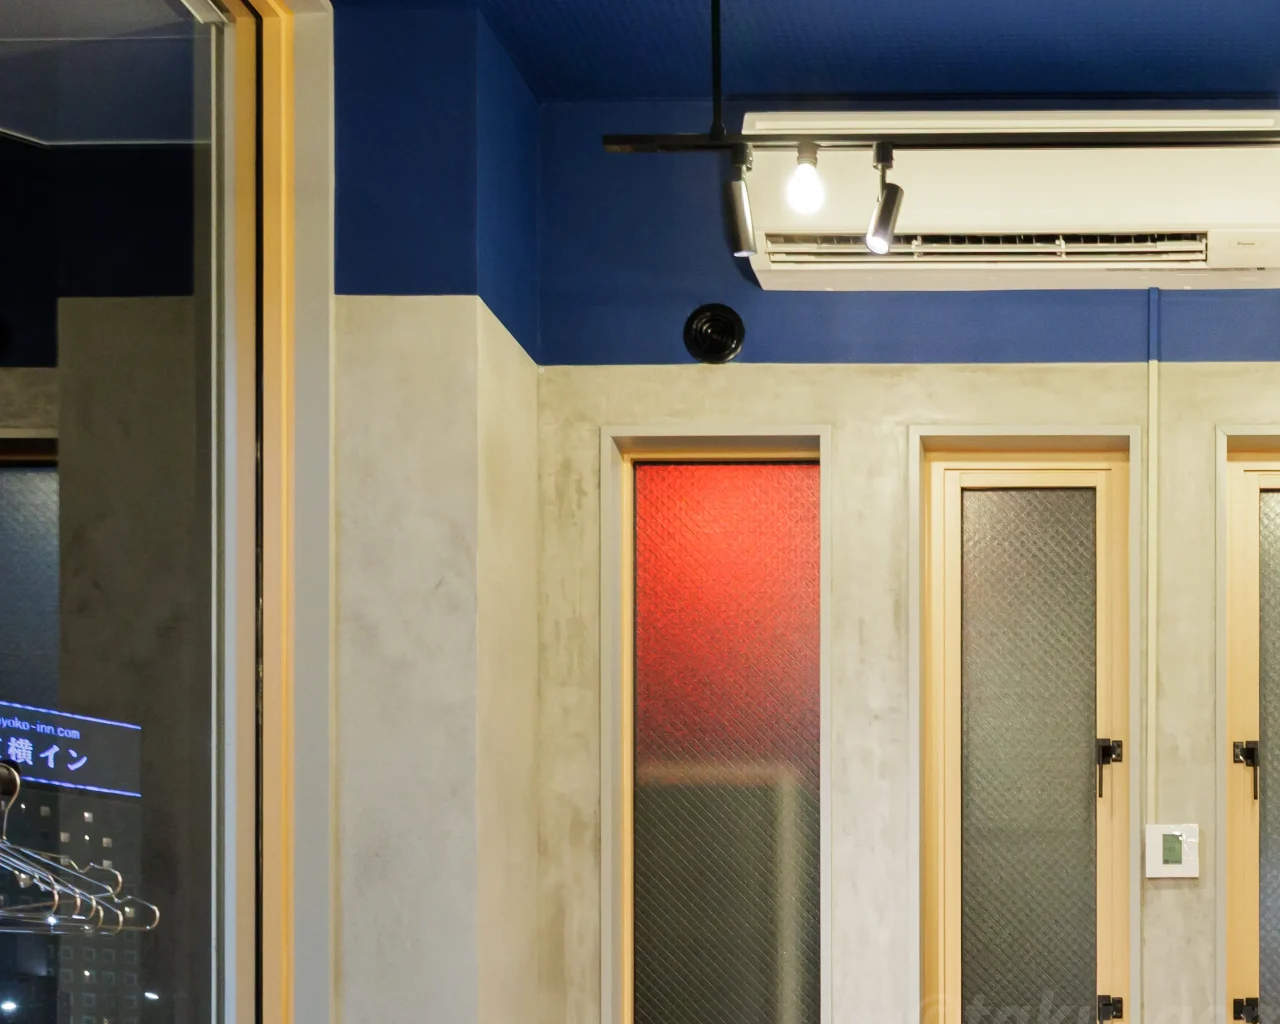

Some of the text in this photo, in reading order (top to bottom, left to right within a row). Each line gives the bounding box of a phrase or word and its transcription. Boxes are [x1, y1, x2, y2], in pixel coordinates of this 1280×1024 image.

[0, 716, 81, 740] yoko-inn.com
[0, 736, 88, 772] 横イン
